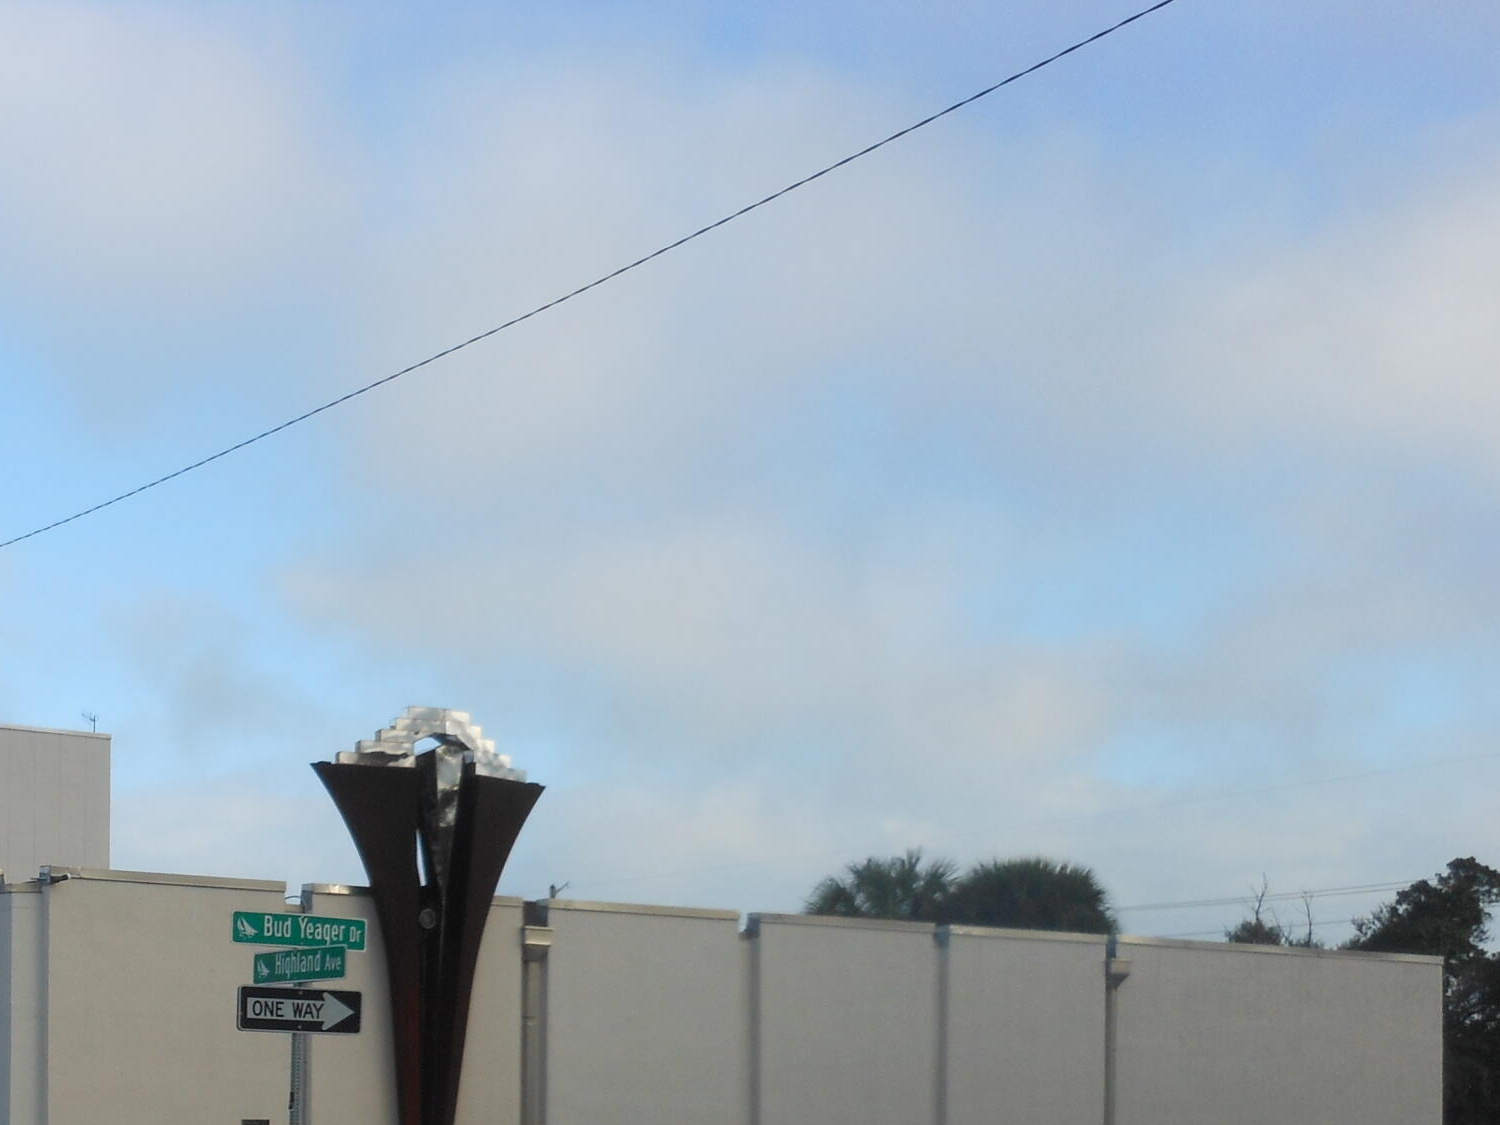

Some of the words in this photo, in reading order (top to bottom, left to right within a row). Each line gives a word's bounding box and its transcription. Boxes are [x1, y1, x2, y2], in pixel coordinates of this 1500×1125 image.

[263, 915, 292, 938] Bud
[298, 916, 346, 946] Yeager
[349, 926, 362, 943] Dr
[274, 951, 321, 978] Highland
[324, 955, 342, 971] Ave
[252, 1000, 285, 1018] ONE
[292, 1002, 324, 1019] WAY
